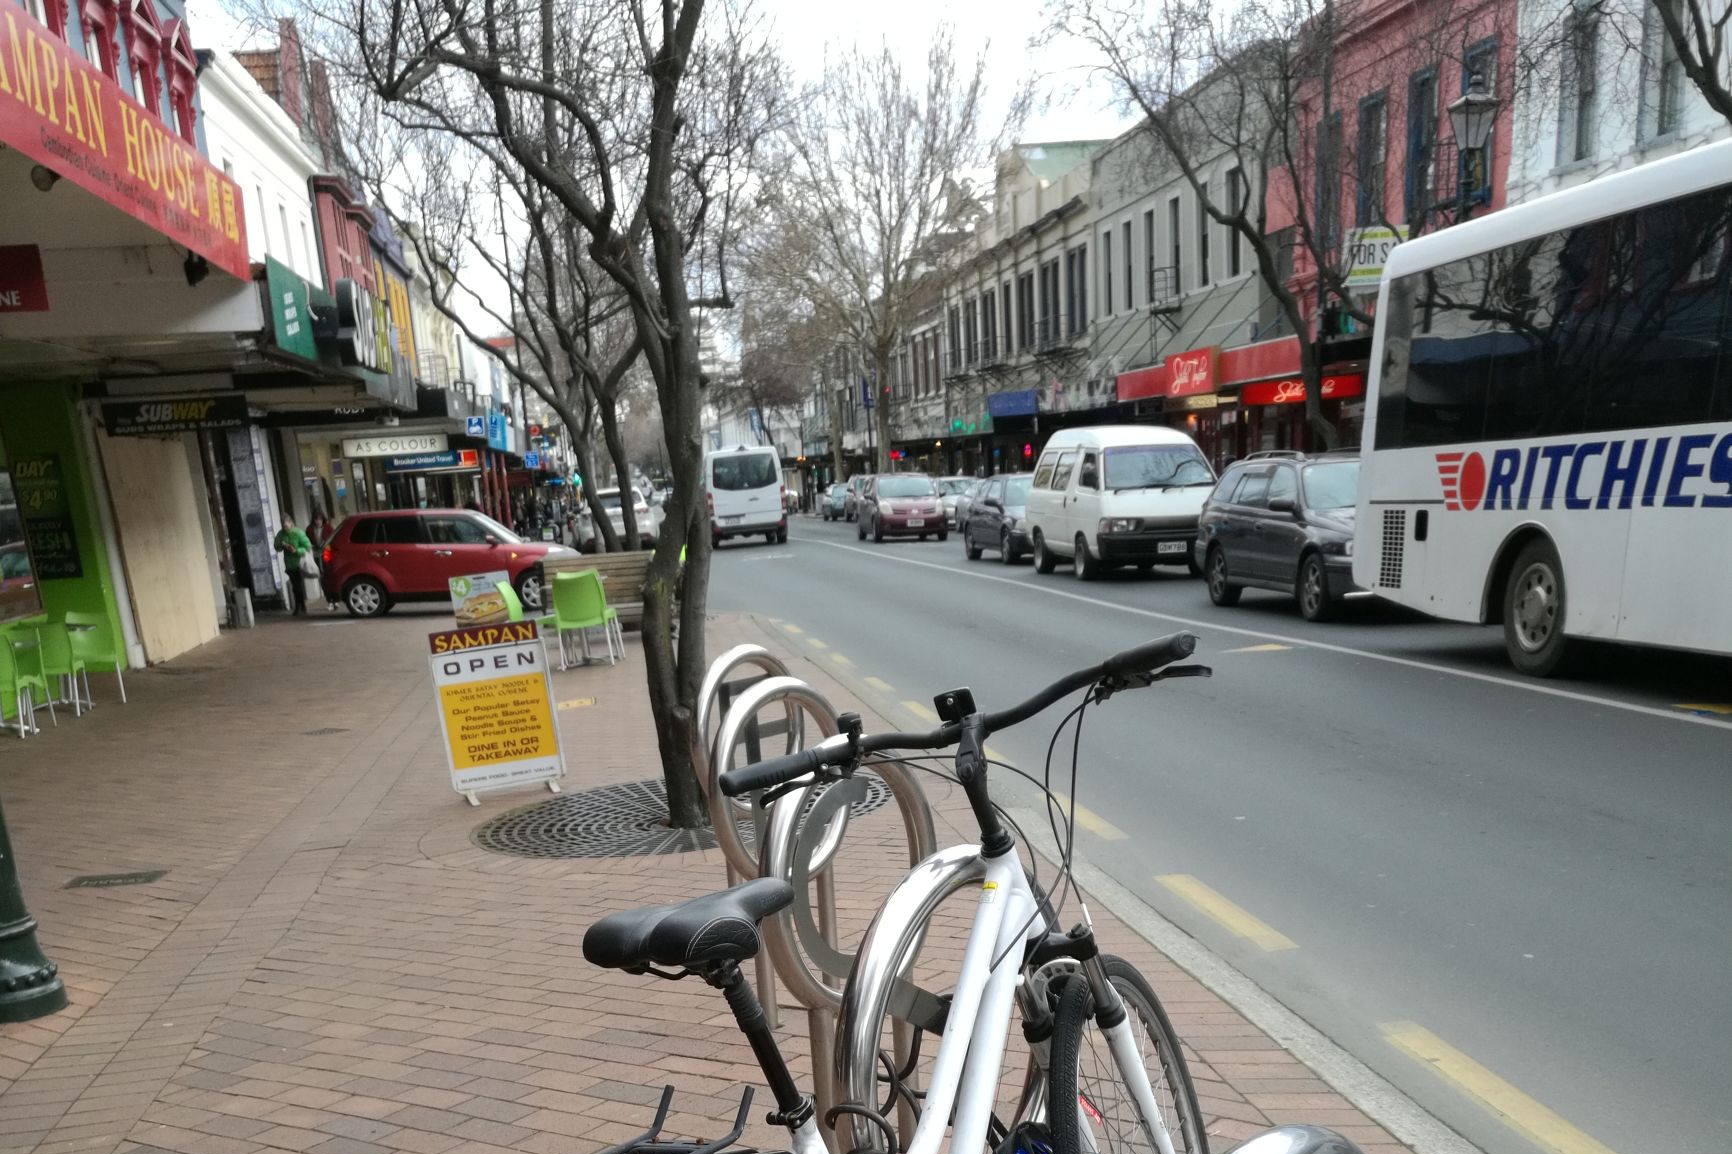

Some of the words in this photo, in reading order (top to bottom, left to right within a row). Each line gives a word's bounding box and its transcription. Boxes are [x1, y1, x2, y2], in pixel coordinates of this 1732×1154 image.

[118, 98, 200, 218] HOUSE
[135, 400, 215, 423] SUBWAY
[355, 442, 371, 454] AS
[378, 437, 438, 452] COLOUR
[16, 460, 53, 478] DAY
[434, 623, 533, 653] SAMPAN
[443, 651, 535, 676] OPEN
[452, 707, 469, 715] Our
[473, 702, 509, 713] Popular
[465, 712, 498, 722] Peanut
[502, 708, 531, 717] Sauce
[460, 732, 480, 741] Stir
[482, 728, 507, 737] Fried
[509, 724, 541, 733] Dishes
[461, 722, 494, 732] Noodle
[497, 717, 527, 727] Soups
[467, 742, 499, 753] DINE
[503, 739, 517, 748] IN
[520, 736, 540, 746] OR
[469, 745, 540, 763] TAKEAWAY
